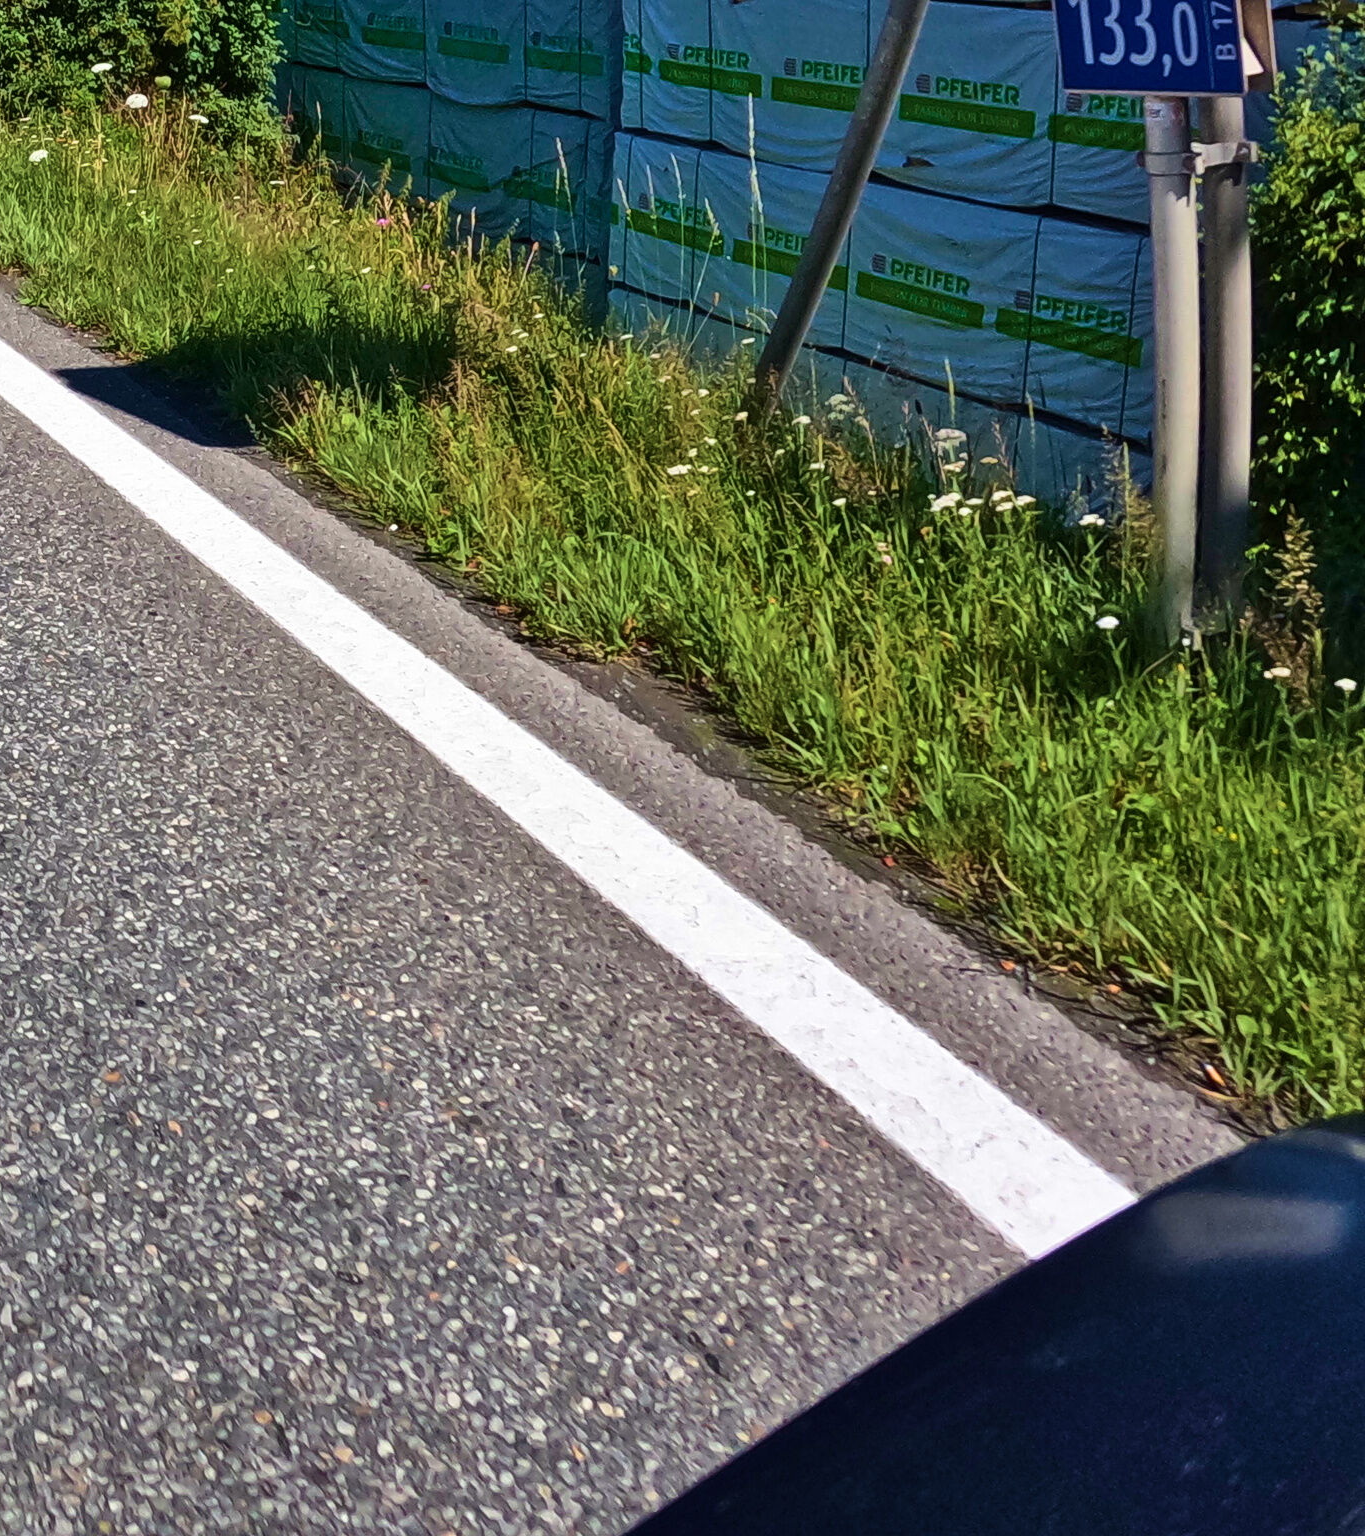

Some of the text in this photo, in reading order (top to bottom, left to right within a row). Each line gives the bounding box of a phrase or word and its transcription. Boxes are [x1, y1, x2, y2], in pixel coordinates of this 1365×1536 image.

[683, 46, 750, 70] PFEIFER
[1215, 42, 1237, 60] B
[801, 60, 867, 85] PFEIFE
[935, 76, 1020, 106] PFEIFER
[1088, 93, 1145, 119] PFEI
[890, 258, 970, 297] PFEIFER
[1036, 294, 1128, 332] PFEIFER
